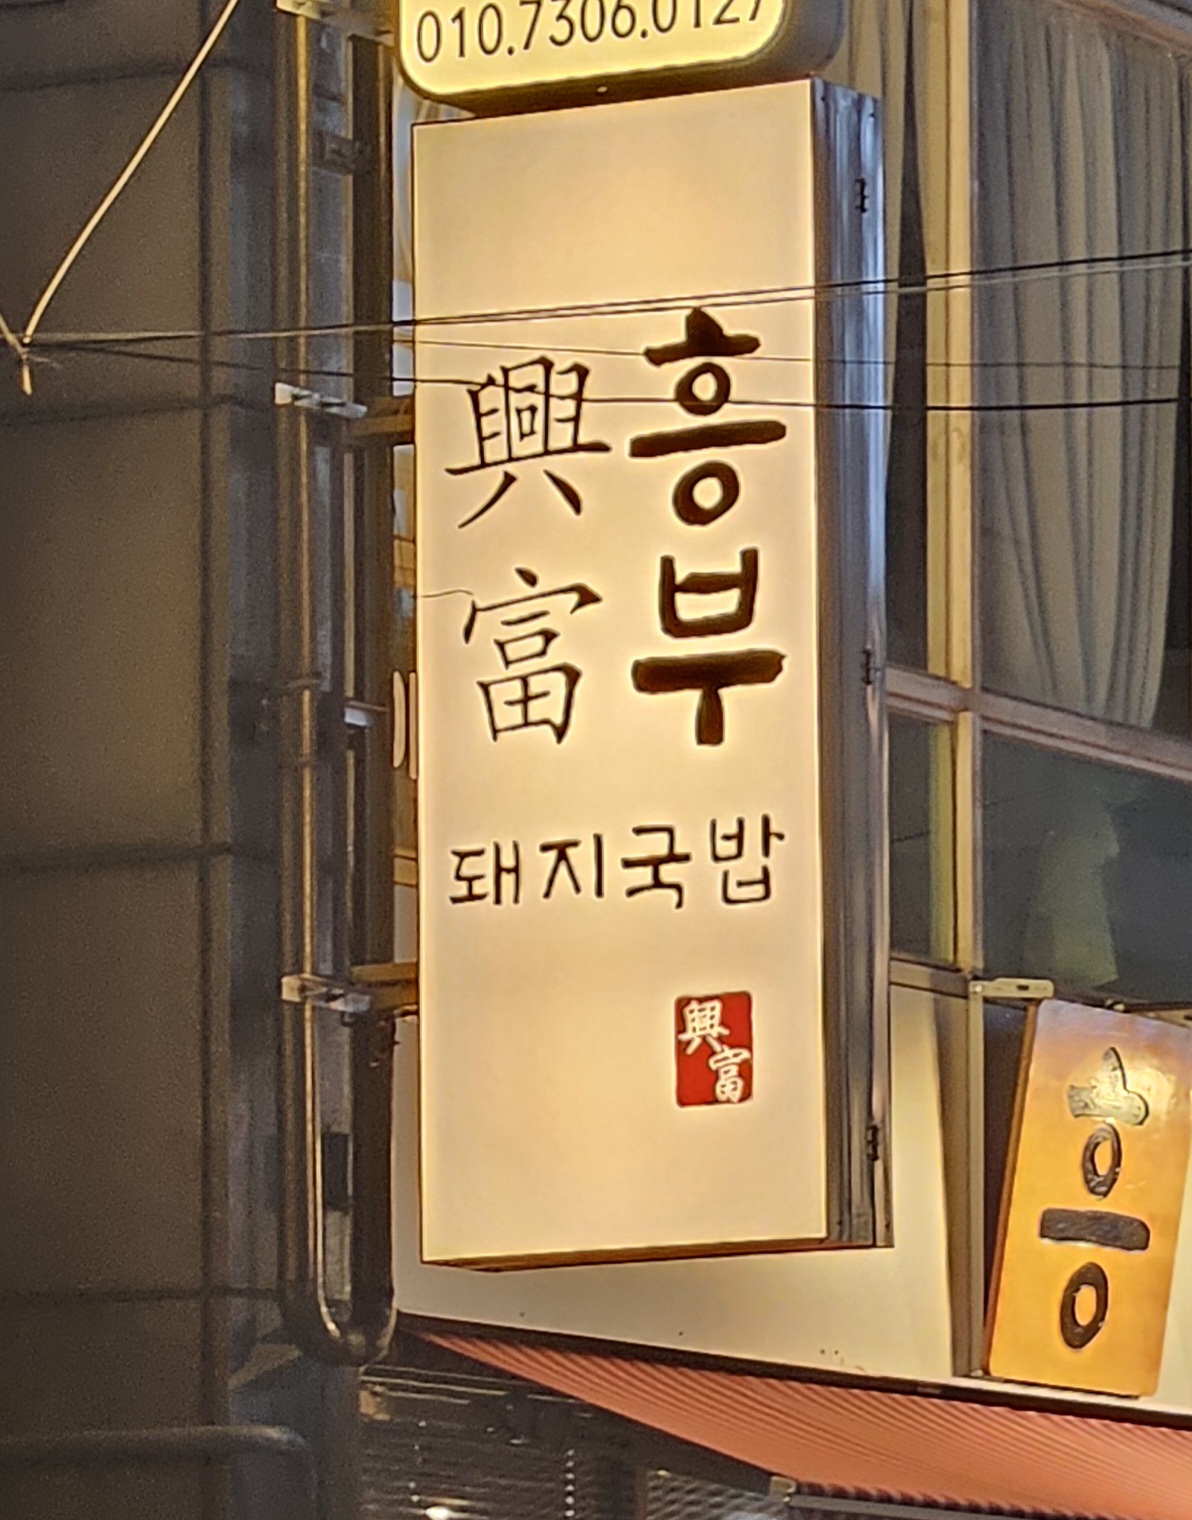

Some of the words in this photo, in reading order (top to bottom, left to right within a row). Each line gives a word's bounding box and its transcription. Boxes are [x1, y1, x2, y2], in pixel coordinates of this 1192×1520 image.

[445, 356, 612, 746] 興富
[629, 306, 788, 746] 흥부
[448, 814, 786, 909] 돼지국밥
